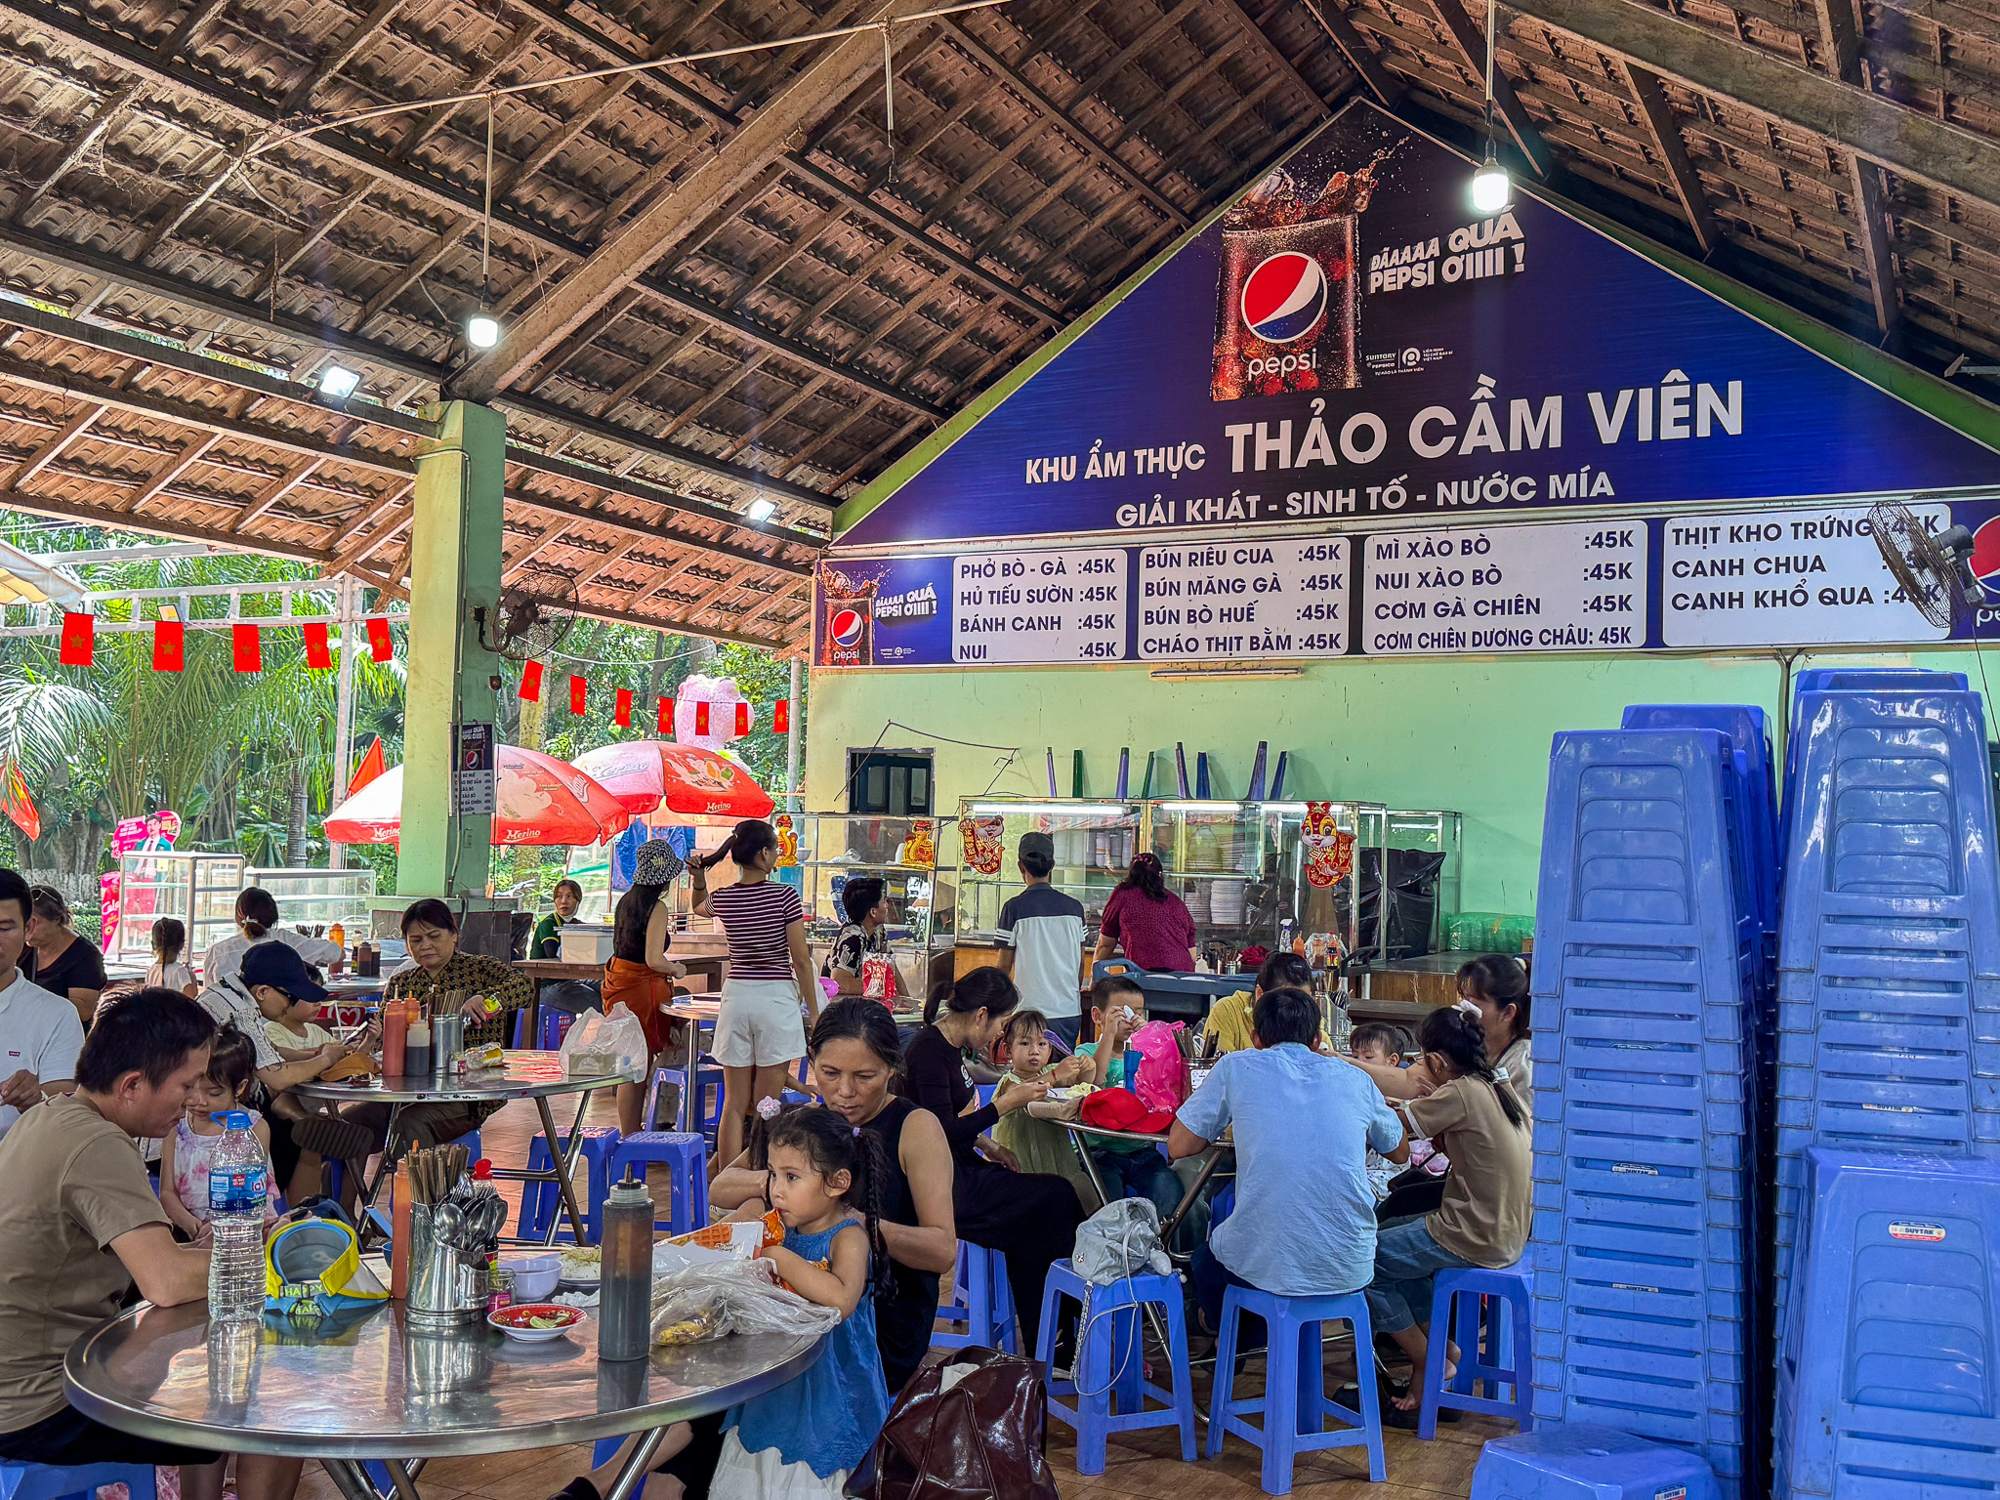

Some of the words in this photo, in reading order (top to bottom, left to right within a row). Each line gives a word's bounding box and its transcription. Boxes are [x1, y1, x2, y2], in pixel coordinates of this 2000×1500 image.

[1448, 204, 1525, 253] QUÁ
[1370, 260, 1435, 294] PEPSI
[1512, 243, 1525, 273] !
[1248, 348, 1320, 381] pepsi
[1025, 455, 1077, 484] KHU
[1084, 438, 1126, 479] ẨM
[1133, 440, 1206, 479] THỰC
[1224, 397, 1388, 473] THẢO
[1408, 373, 1563, 459] CẦM
[1587, 368, 1743, 445] VIÊN
[1115, 494, 1175, 527] GIẢI
[1186, 489, 1261, 522] KHÁT
[1286, 488, 1357, 517] SINH
[1365, 474, 1408, 510] TỐ
[1436, 470, 1537, 506] NƯỚC
[1549, 464, 1615, 499] MÍA
[1376, 538, 1400, 561] MÌ
[1406, 536, 1454, 559] XÀO
[1460, 533, 1491, 556] BÒ
[1584, 530, 1635, 550] :45K
[1672, 526, 1721, 550] THỊT
[1729, 523, 1782, 544] KHO
[1790, 515, 1875, 540] TRỨNG
[961, 558, 996, 579] PHỞ
[1001, 558, 1025, 577] BÒ
[1040, 556, 1067, 576] GÀ
[1077, 558, 1116, 575] :45K
[1145, 549, 1181, 569] BÚN
[1187, 546, 1227, 567] RIÊU
[1233, 548, 1274, 565] CUA
[1298, 543, 1341, 562] :45K
[1671, 558, 1744, 578] CANH
[1753, 554, 1827, 575] CHUA
[1144, 577, 1181, 597] BÚN
[1187, 575, 1247, 596] MĂNG
[1252, 572, 1282, 593] GÀ
[1300, 573, 1344, 592] :45K
[1375, 572, 1409, 590] NUI
[1416, 566, 1465, 589] XÀO
[1472, 563, 1503, 586] BÒ
[1583, 562, 1633, 581] :45K
[907, 582, 937, 603] QUÁ
[960, 585, 983, 606] HỦ
[988, 583, 1021, 605] TIẾU
[1026, 584, 1073, 604] SƯỜN
[1079, 585, 1118, 602] :45K
[1671, 591, 1744, 611] CANH
[1753, 578, 1810, 609] KHỔ
[1817, 586, 1875, 607] QUA
[875, 604, 902, 618] PEPSI
[1144, 605, 1180, 626] BÚN
[1186, 604, 1213, 624] BÒ
[1219, 600, 1259, 623] HUẾ
[1296, 603, 1340, 621] :45K
[1374, 601, 1426, 620] CƠM
[1433, 596, 1467, 618] GÀ
[1473, 593, 1541, 617] CHIÊN
[1583, 594, 1633, 613] :45K
[960, 614, 1006, 633] BÁNH
[1011, 615, 1062, 632] CANH
[1077, 614, 1116, 630] :45K
[1374, 630, 1413, 650] CƠM
[1417, 627, 1466, 649] CHIÊN
[1472, 627, 1534, 648] DƯƠNG
[1538, 623, 1594, 646] CHÂU:
[1599, 626, 1632, 644] 45K
[959, 645, 987, 660] NUI
[1079, 642, 1117, 658] :45K
[1143, 633, 1199, 654] CHÁO
[1205, 635, 1244, 656] THỊT
[1249, 627, 1292, 651] BẰM
[1298, 633, 1342, 650] :45K
[833, 649, 860, 661] pepsi
[503, 828, 541, 842] Merino
